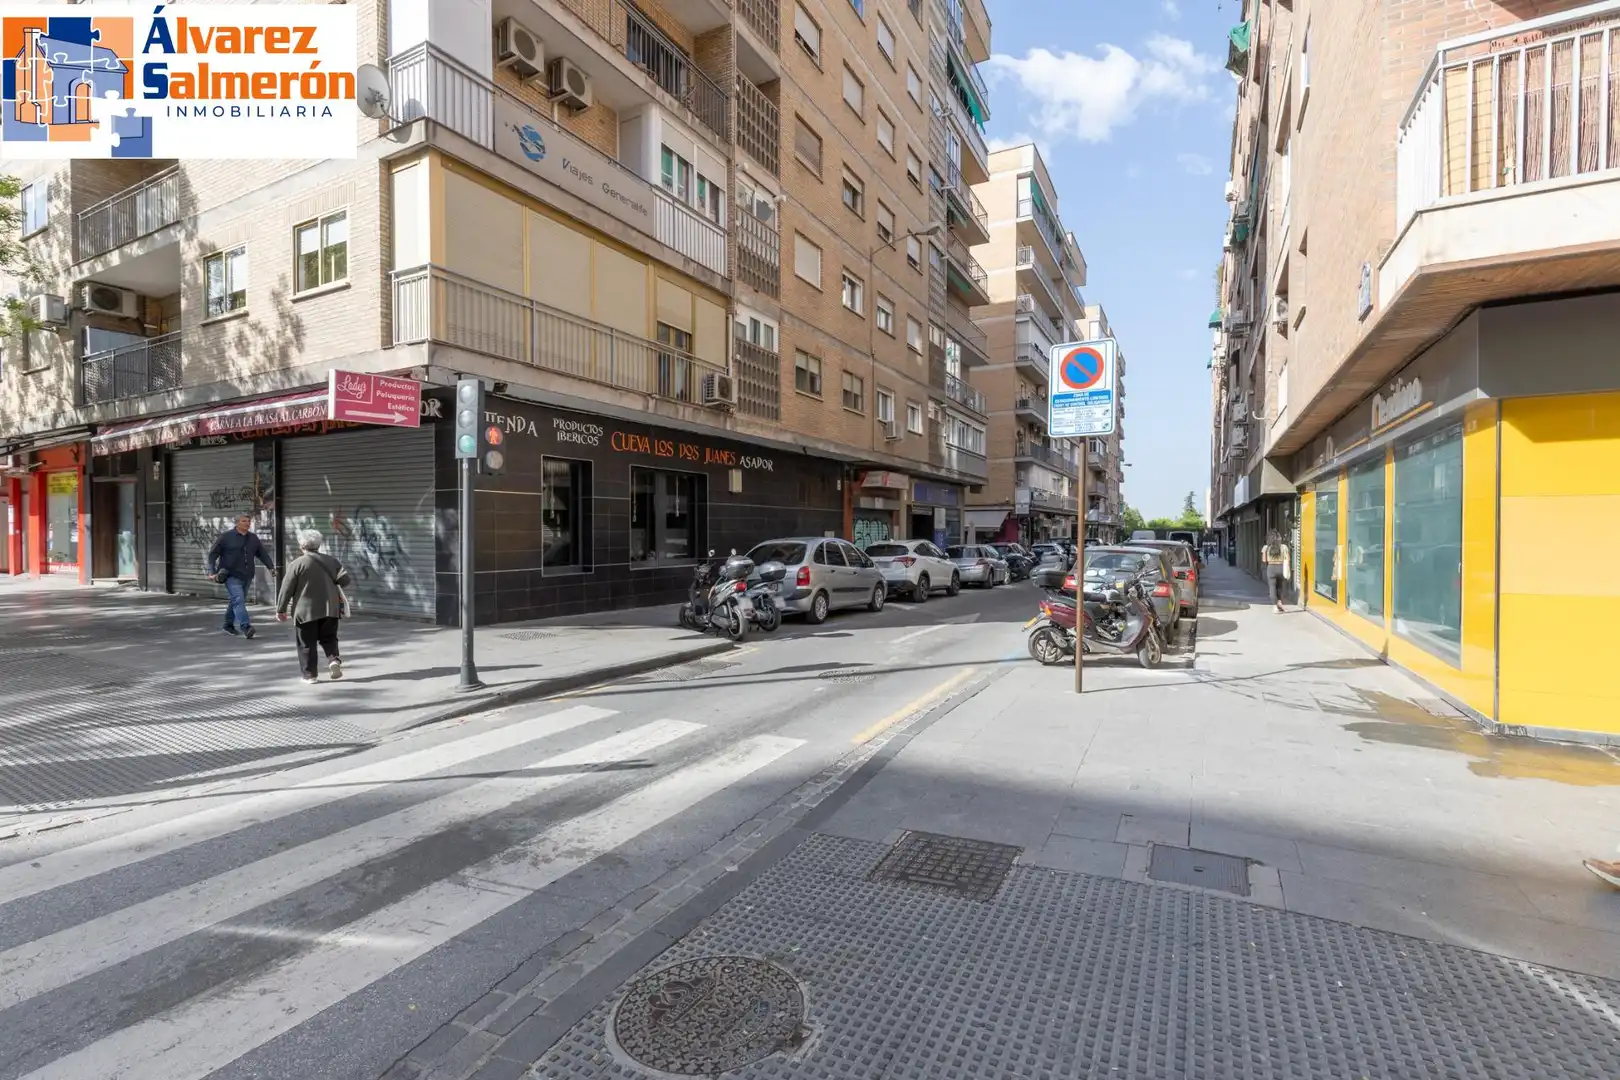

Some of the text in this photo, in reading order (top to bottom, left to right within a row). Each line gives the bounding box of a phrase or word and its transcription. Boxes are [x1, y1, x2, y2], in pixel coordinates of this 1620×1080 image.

[562, 158, 648, 216] Viajes Generalife
[380, 379, 416, 391] Productos
[484, 411, 538, 437] TIENDA
[553, 418, 604, 436] PRODUCTOS
[557, 431, 599, 446] IBERICOS
[611, 432, 773, 471] CUEVA LOS DOS JUANES ASADOR
